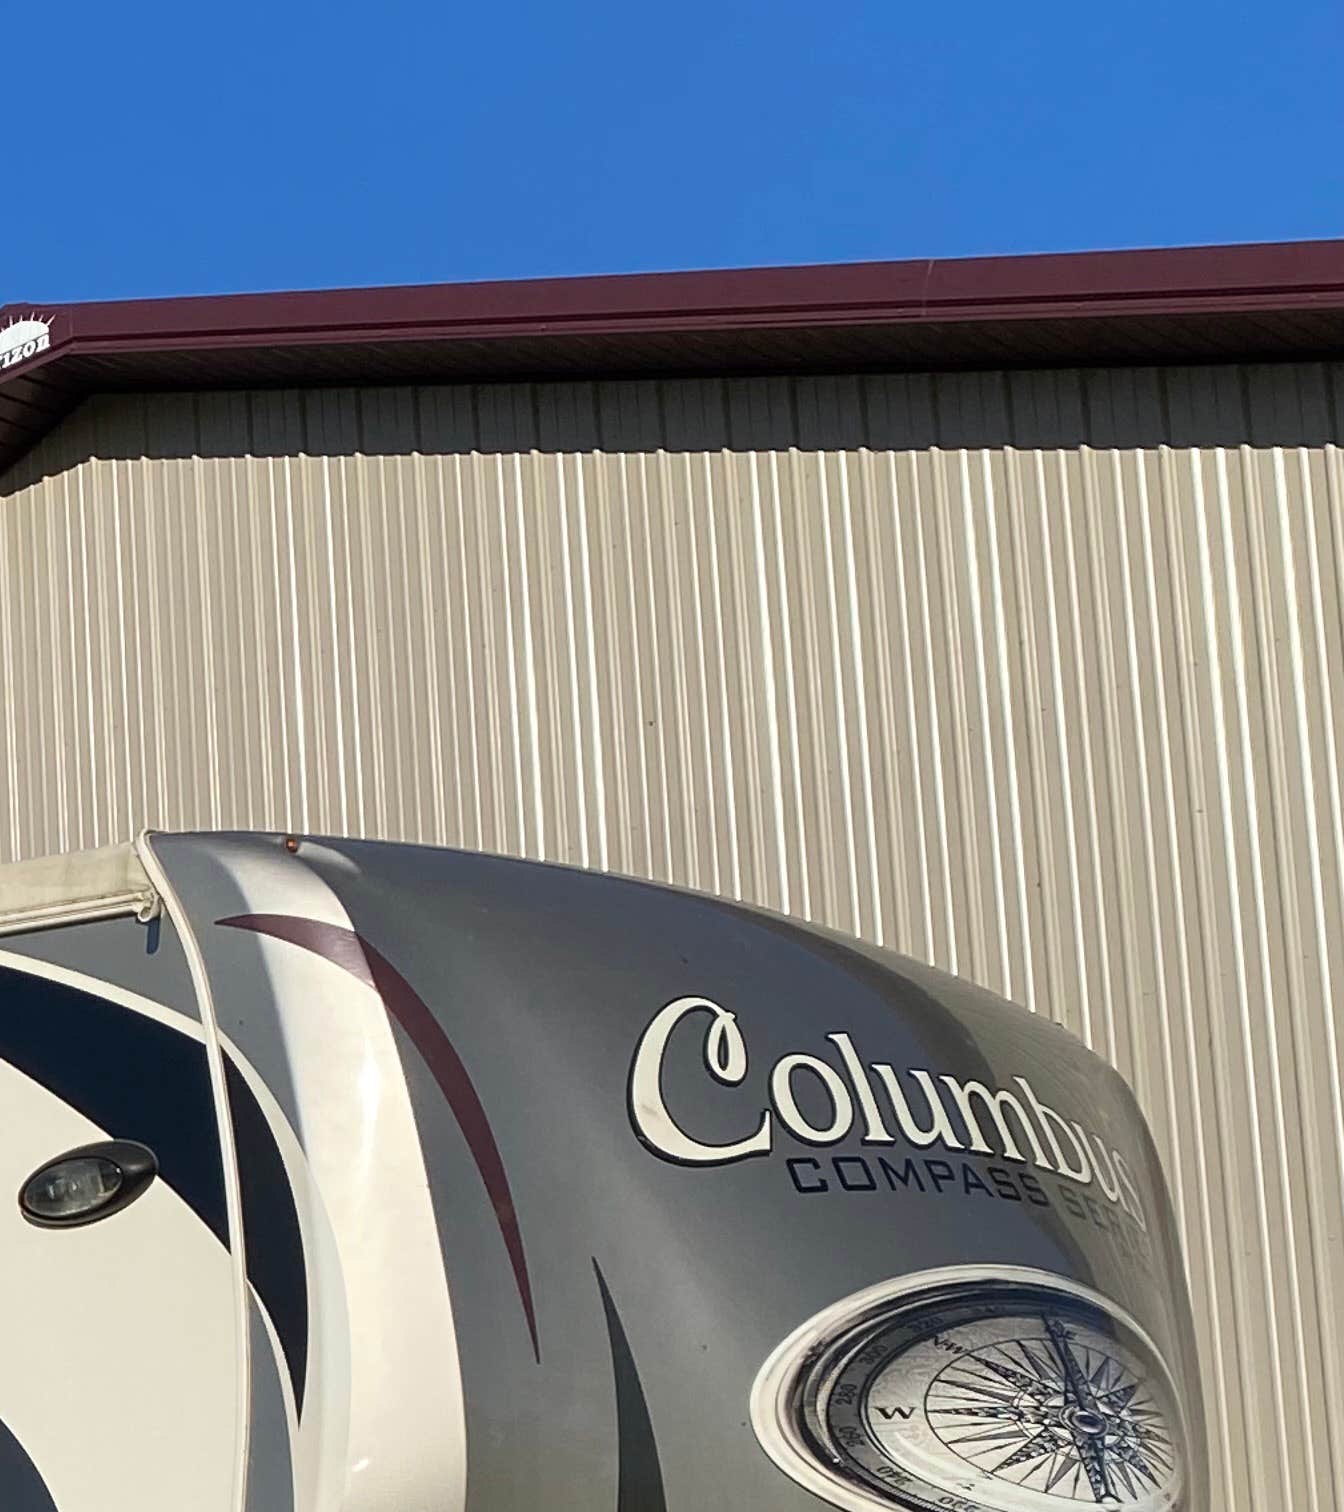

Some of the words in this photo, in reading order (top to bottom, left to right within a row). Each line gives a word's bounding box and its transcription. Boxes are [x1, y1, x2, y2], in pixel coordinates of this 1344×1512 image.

[627, 995, 1148, 1233] Columbus
[785, 1156, 1051, 1207] COMPASS
[874, 1406, 916, 1420] W
